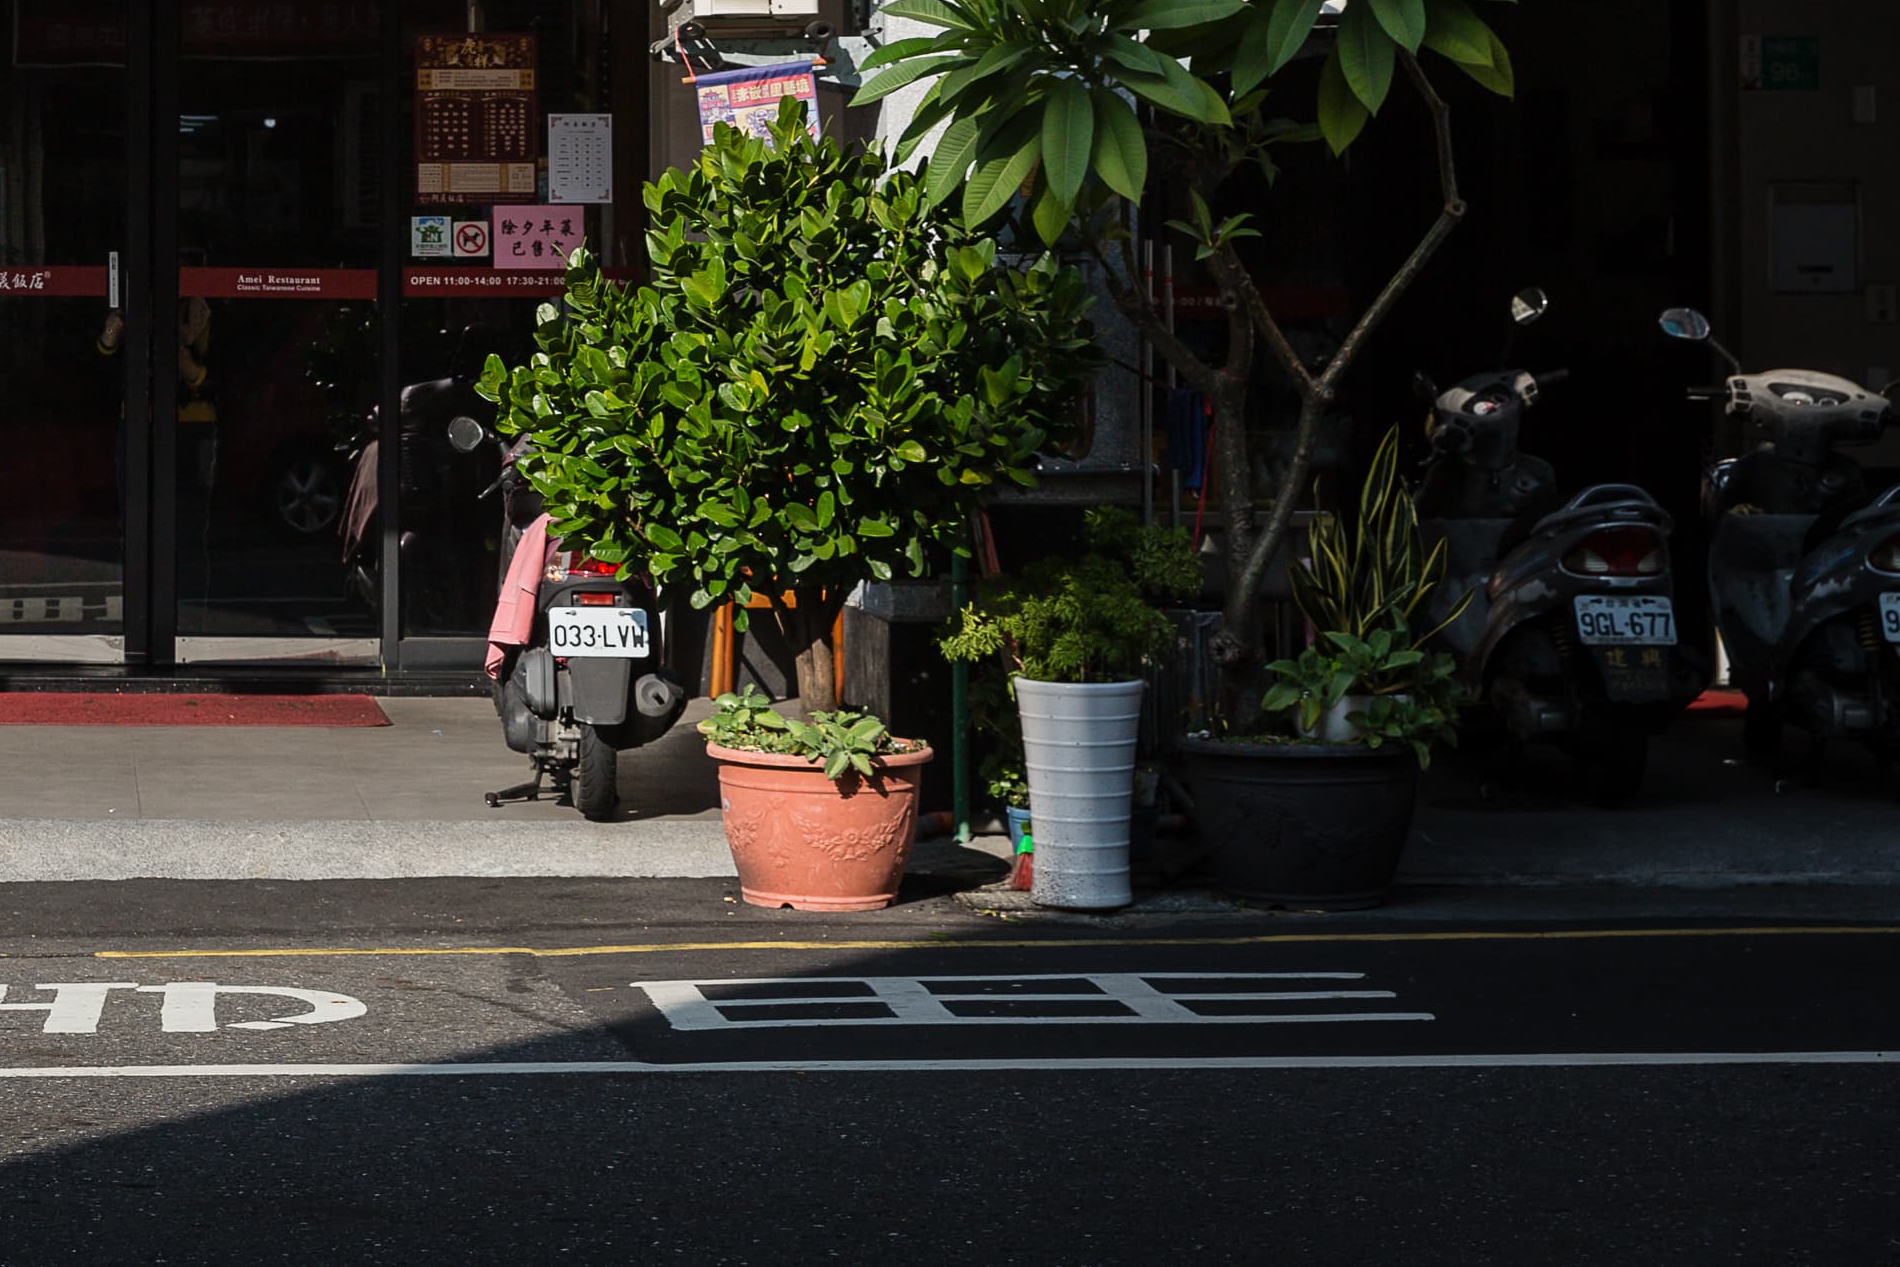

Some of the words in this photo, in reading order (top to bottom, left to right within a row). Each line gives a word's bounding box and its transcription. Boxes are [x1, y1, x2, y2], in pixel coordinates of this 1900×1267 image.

[501, 219, 576, 237] 除夕年菜
[237, 274, 263, 284] Amei
[267, 274, 321, 285] Restaurant
[411, 277, 441, 286] OPEN
[444, 276, 501, 286] 11:00-14:00
[506, 276, 565, 286] 17:30-21:00
